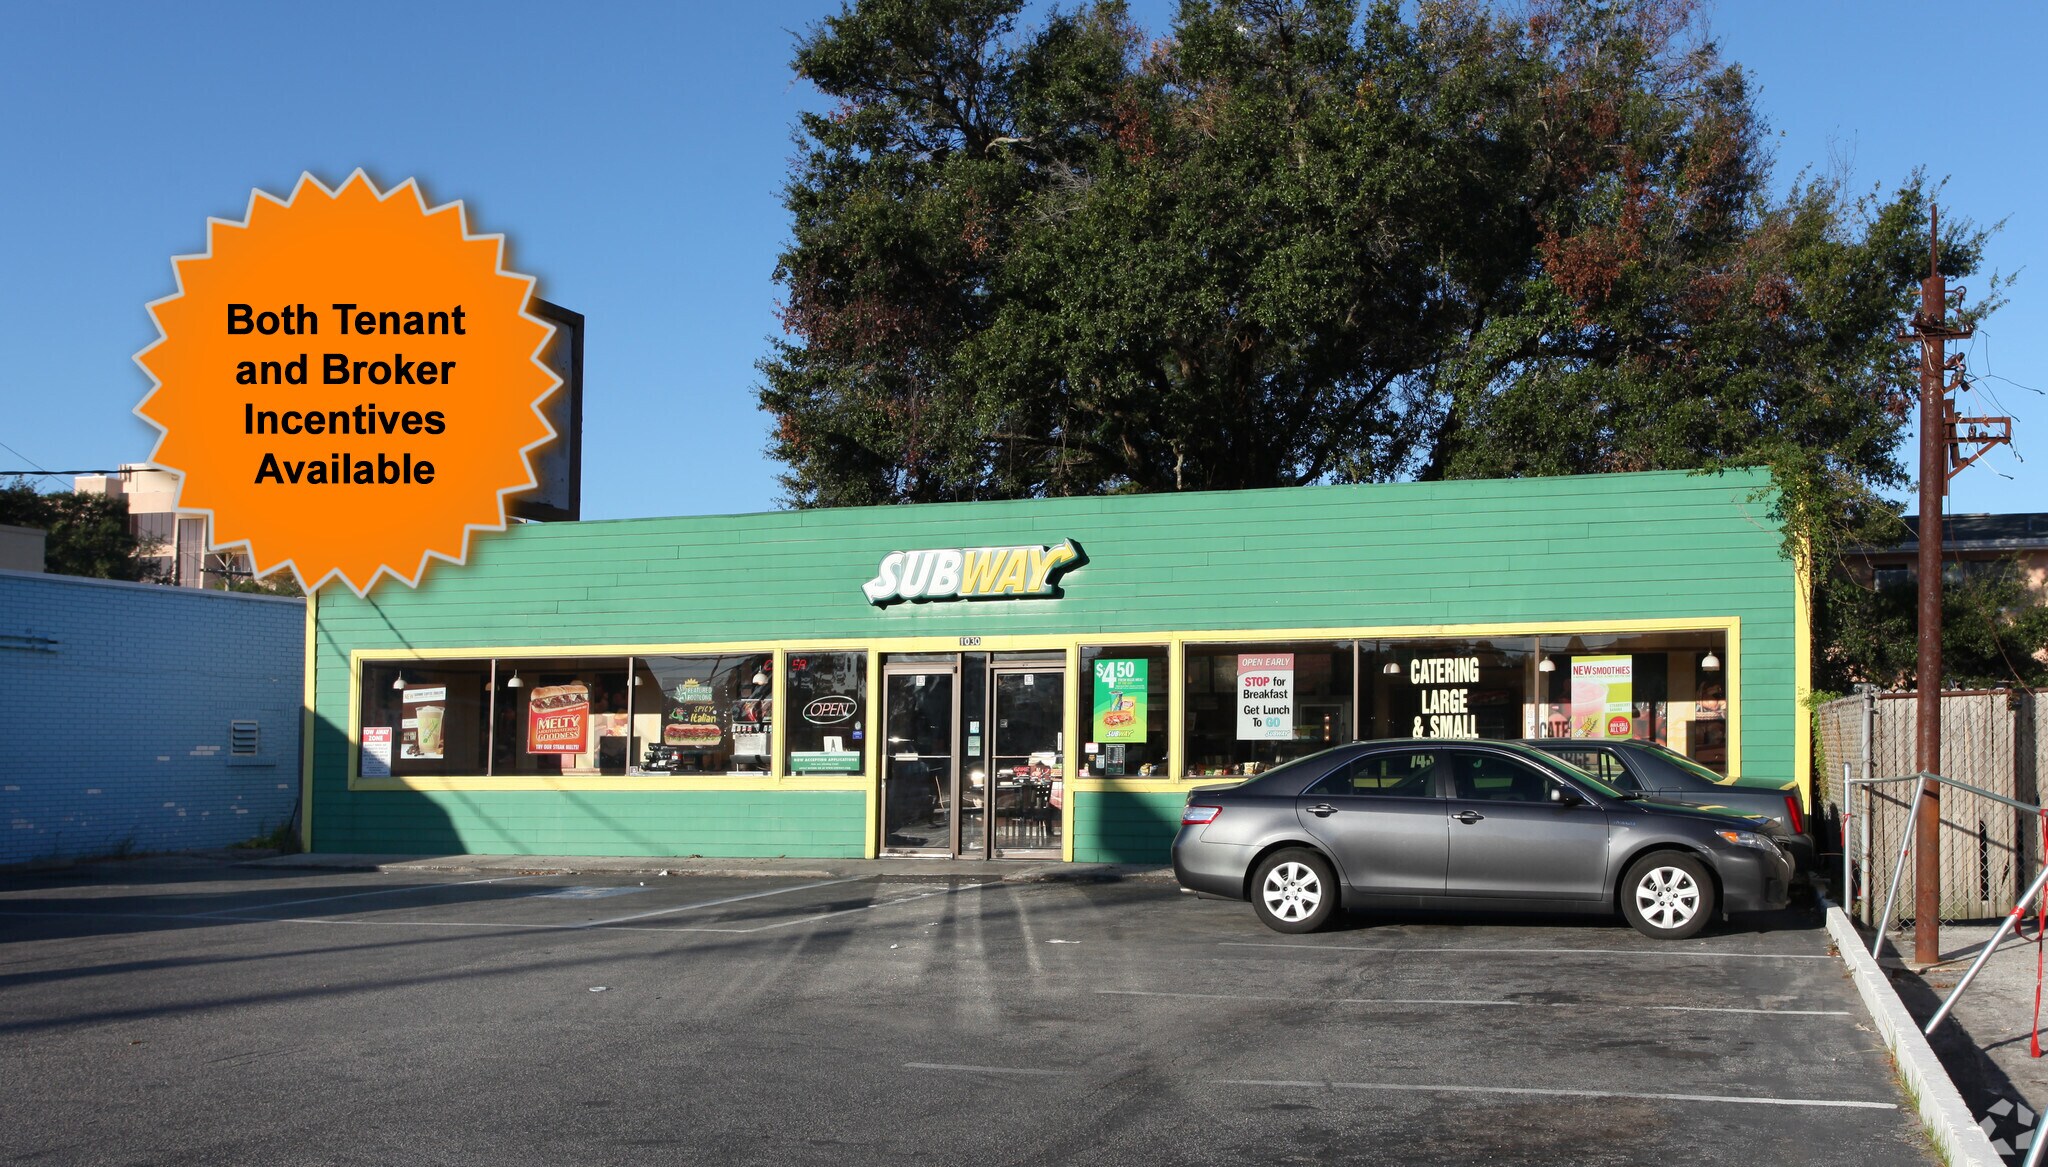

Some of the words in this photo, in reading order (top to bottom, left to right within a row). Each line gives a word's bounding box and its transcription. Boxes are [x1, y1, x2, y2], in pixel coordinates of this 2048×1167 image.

[863, 538, 1080, 602] SUBWAY
[960, 637, 981, 645] 1030
[1242, 658, 1263, 667] OPEN
[1265, 657, 1291, 666] EARLY
[1410, 657, 1480, 684] CATERING
[1573, 665, 1591, 675] NEW
[1592, 666, 1630, 675] SMOOTHIES
[1245, 677, 1270, 687] STOP
[1273, 676, 1286, 686] for
[1243, 689, 1288, 699] Breakfast
[1421, 688, 1468, 714] LARGE
[811, 703, 849, 716] OPEN
[1243, 705, 1260, 715] Get
[1263, 704, 1290, 715] Lunch
[538, 716, 579, 729] MELTY
[691, 713, 716, 723] Italian
[1252, 717, 1262, 727] To
[1265, 717, 1280, 727] GO
[1412, 715, 1424, 739] &
[1429, 714, 1480, 739] SMALL
[538, 732, 579, 740] GOODNESS
